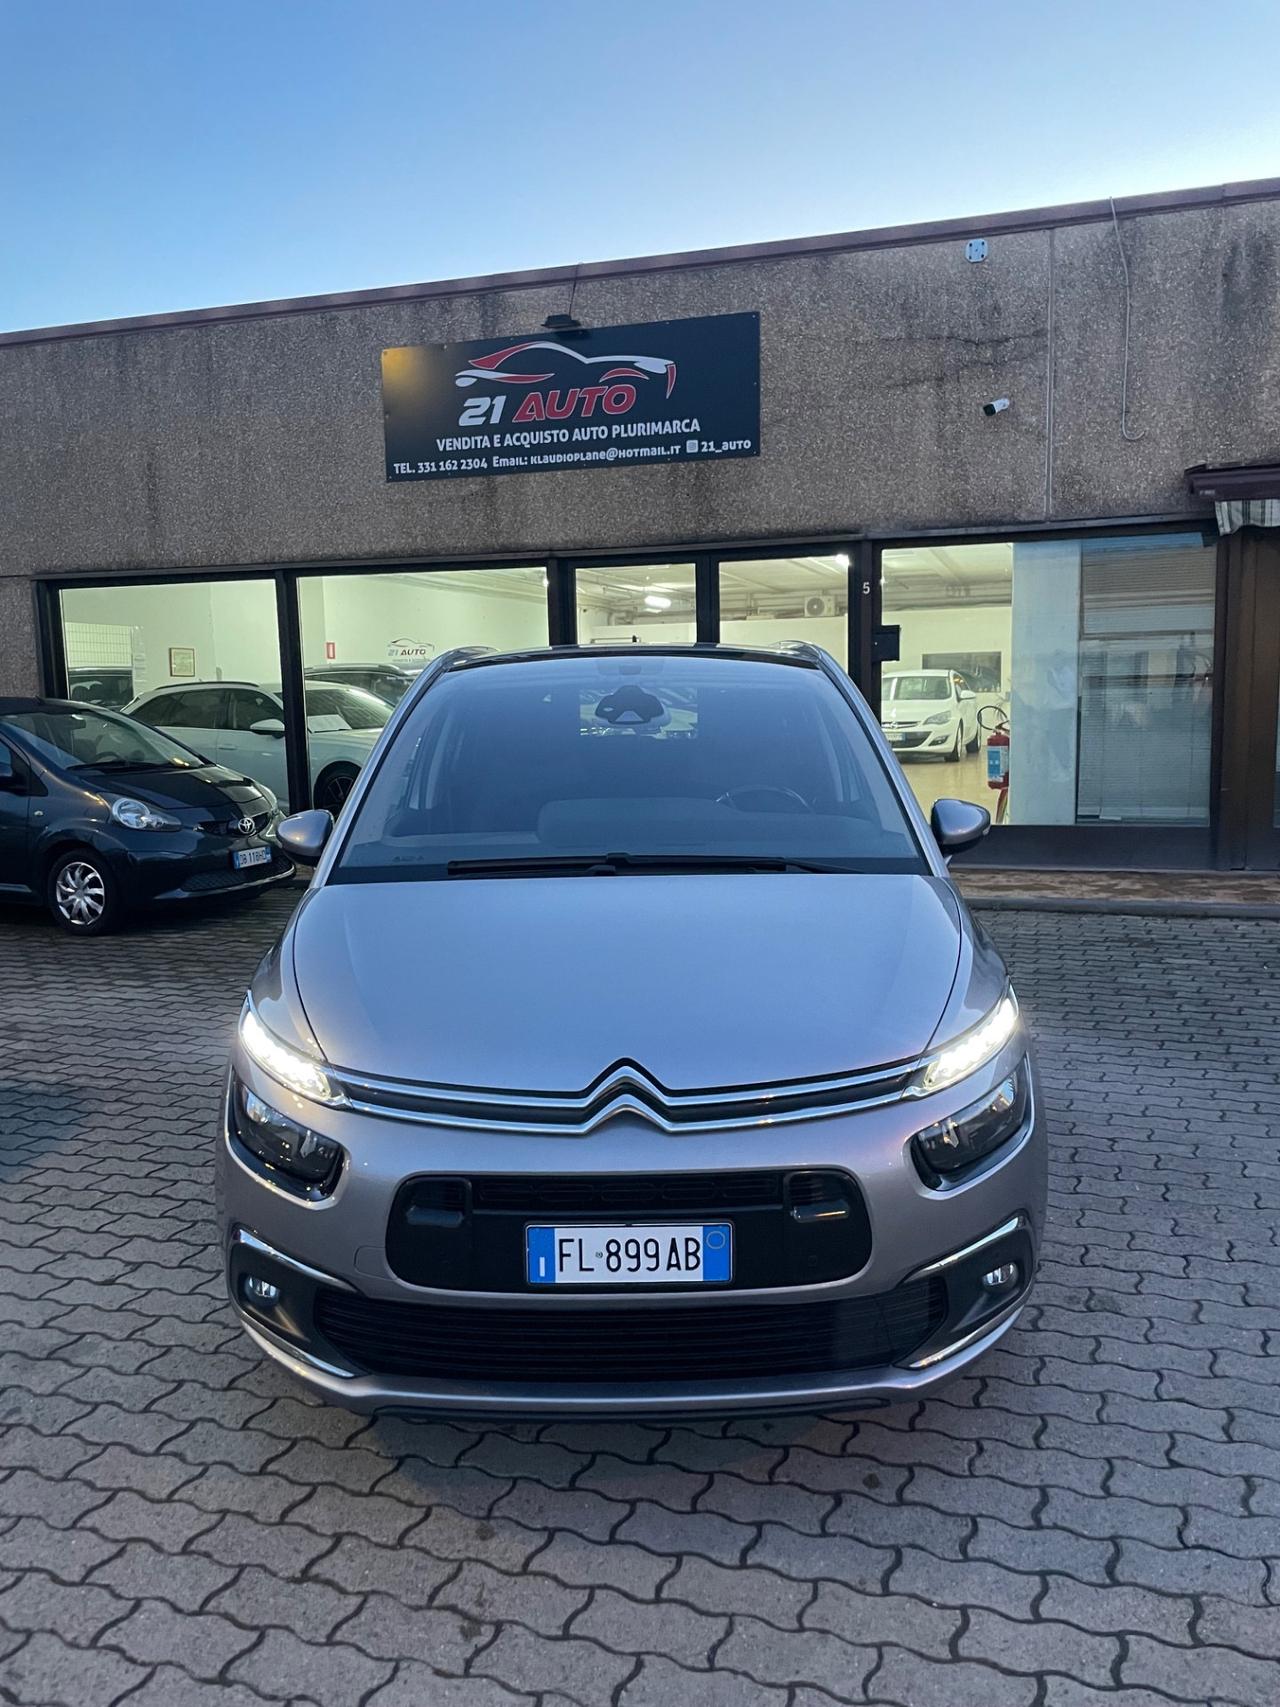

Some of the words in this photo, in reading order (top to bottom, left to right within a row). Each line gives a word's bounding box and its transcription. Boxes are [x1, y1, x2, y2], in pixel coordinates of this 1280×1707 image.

[458, 394, 507, 427] 21
[512, 384, 637, 424] AUTO
[436, 434, 490, 452] VENDITA
[493, 433, 501, 447] E
[504, 428, 570, 448] ACQUISTO
[572, 425, 609, 442] AUTO
[612, 418, 701, 438] PLURIMARCA
[393, 462, 416, 475] TEL.
[417, 461, 437, 474] 331
[439, 459, 458, 472] 162
[460, 457, 488, 470] 2304
[862, 582, 870, 594] 5
